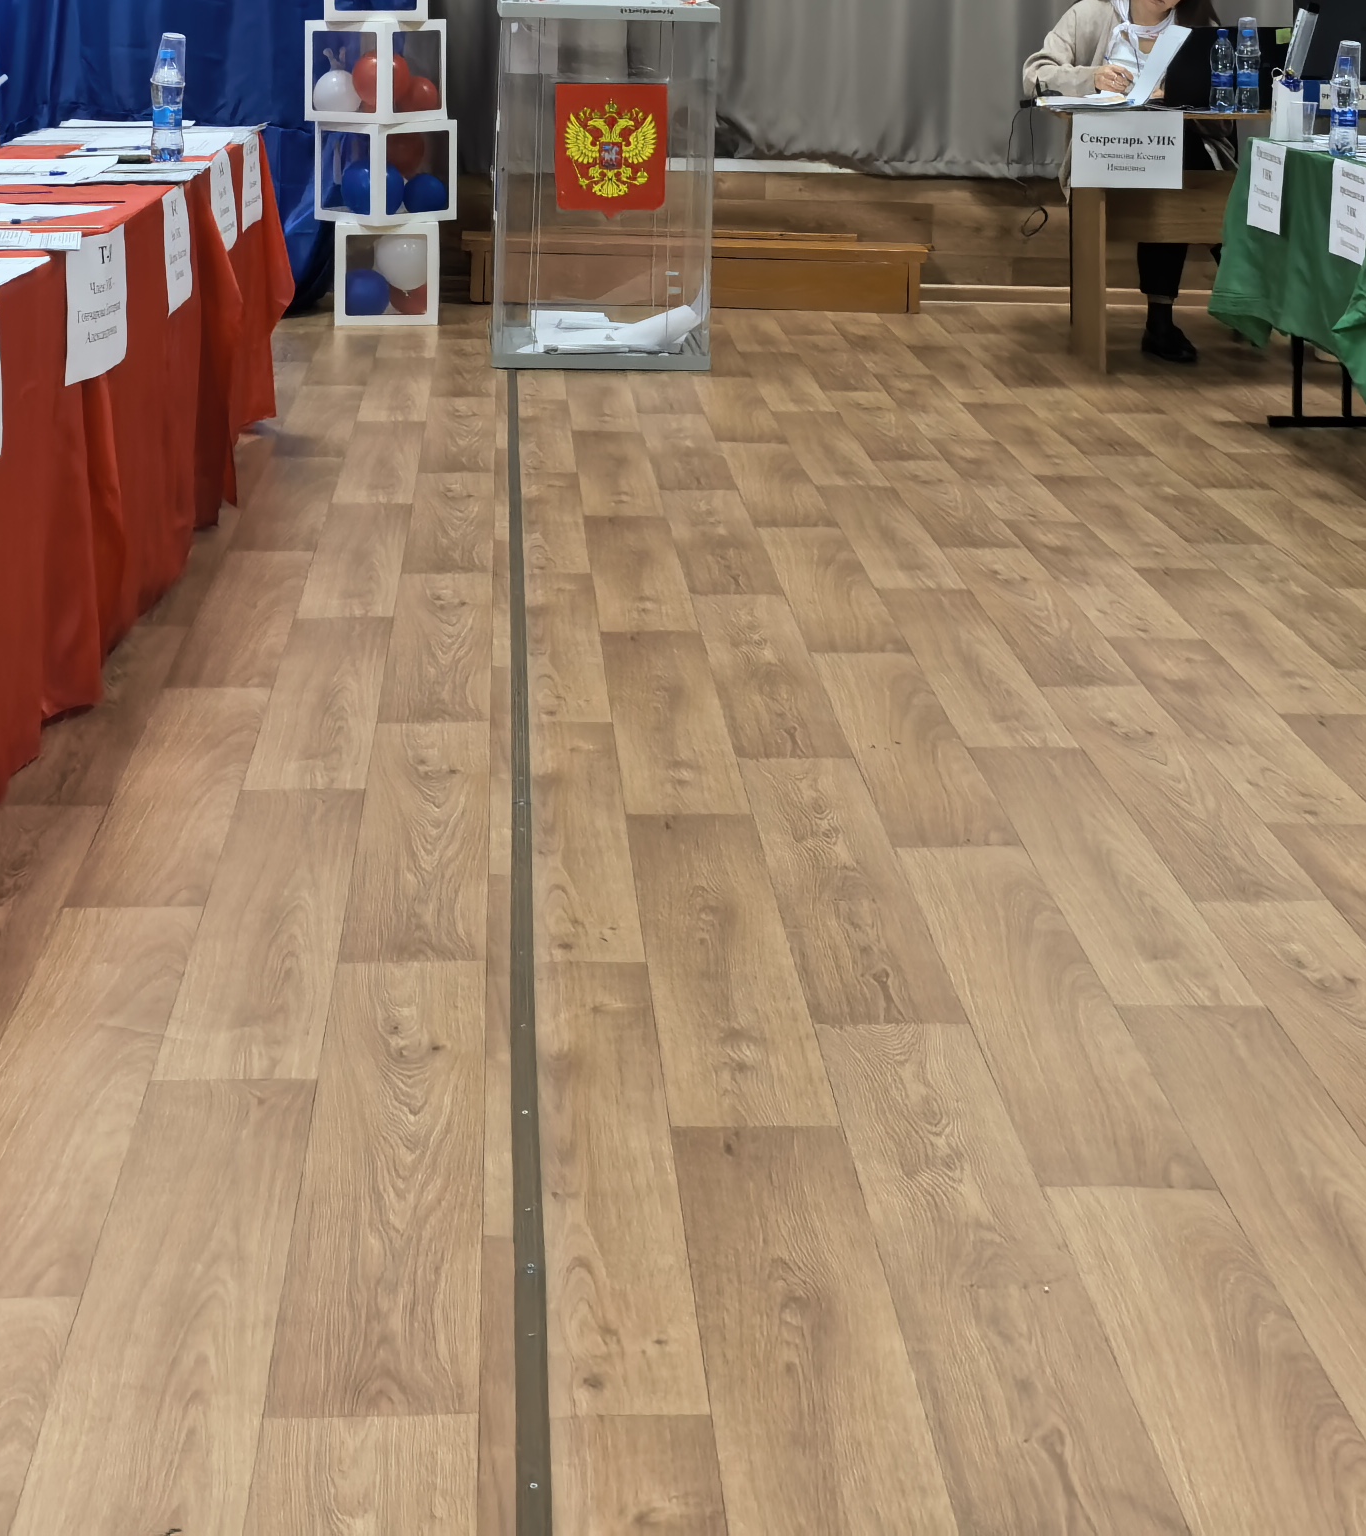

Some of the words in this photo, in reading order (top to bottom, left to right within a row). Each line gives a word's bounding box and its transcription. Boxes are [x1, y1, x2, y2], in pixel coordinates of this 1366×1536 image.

[1080, 132, 1144, 148] Секретарь
[1147, 135, 1177, 147] УИК
[1136, 152, 1166, 161] Ксения
